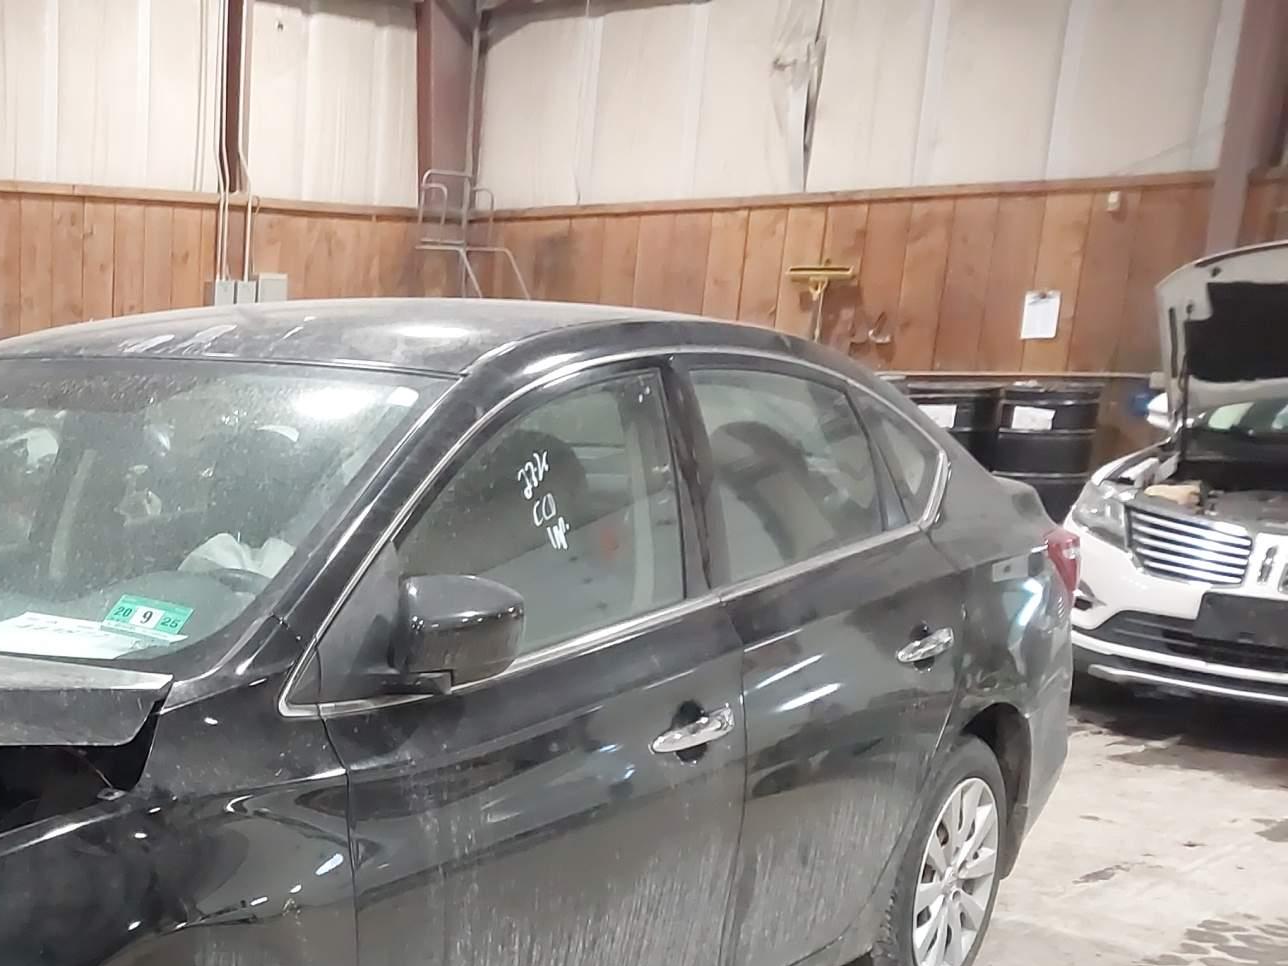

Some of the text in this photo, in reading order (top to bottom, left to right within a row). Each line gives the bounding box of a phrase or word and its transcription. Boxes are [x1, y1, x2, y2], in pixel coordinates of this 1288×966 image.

[113, 606, 133, 618] 20
[139, 610, 154, 625] 9
[160, 616, 181, 629] 25
